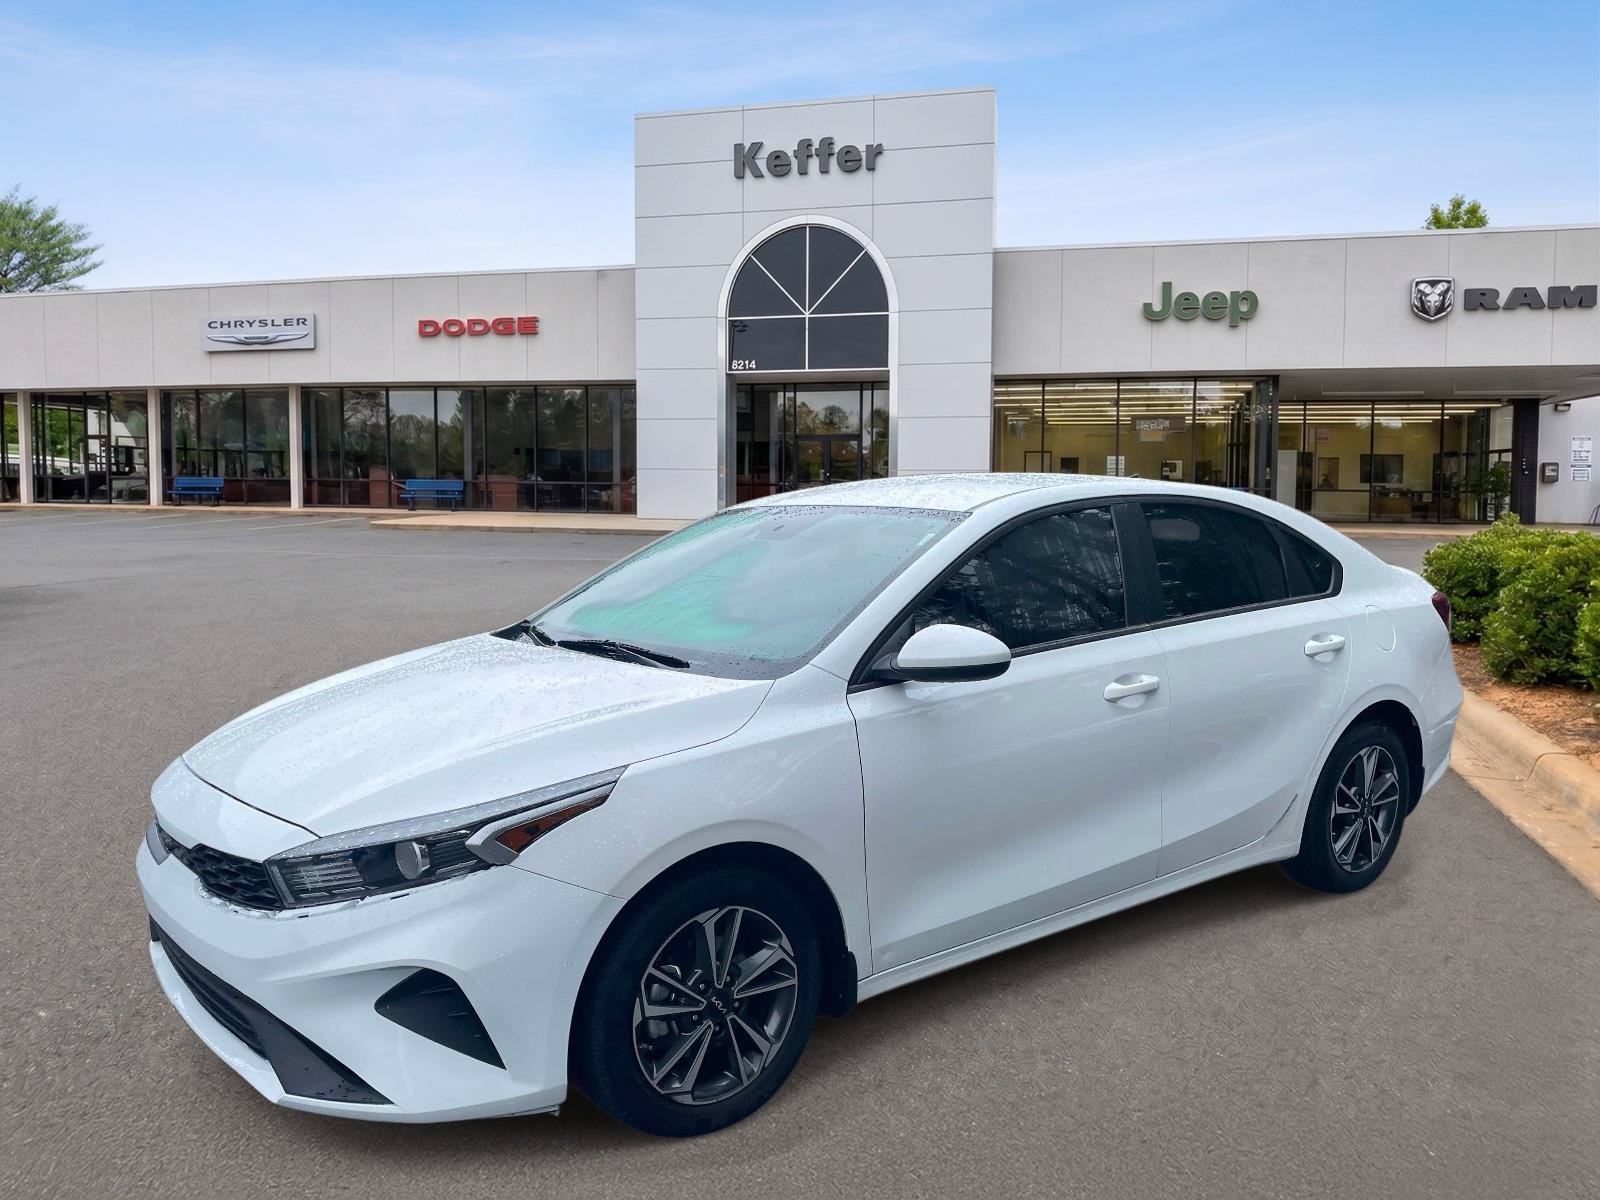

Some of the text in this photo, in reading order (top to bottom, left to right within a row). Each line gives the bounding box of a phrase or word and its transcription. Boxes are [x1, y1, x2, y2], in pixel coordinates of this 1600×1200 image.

[733, 136, 883, 179] Keffer
[1142, 281, 1259, 327] Jeep
[1463, 284, 1598, 311] RAM
[207, 317, 308, 330] CHRYSLER
[418, 316, 539, 338] DODGE
[731, 359, 757, 370] 8214
